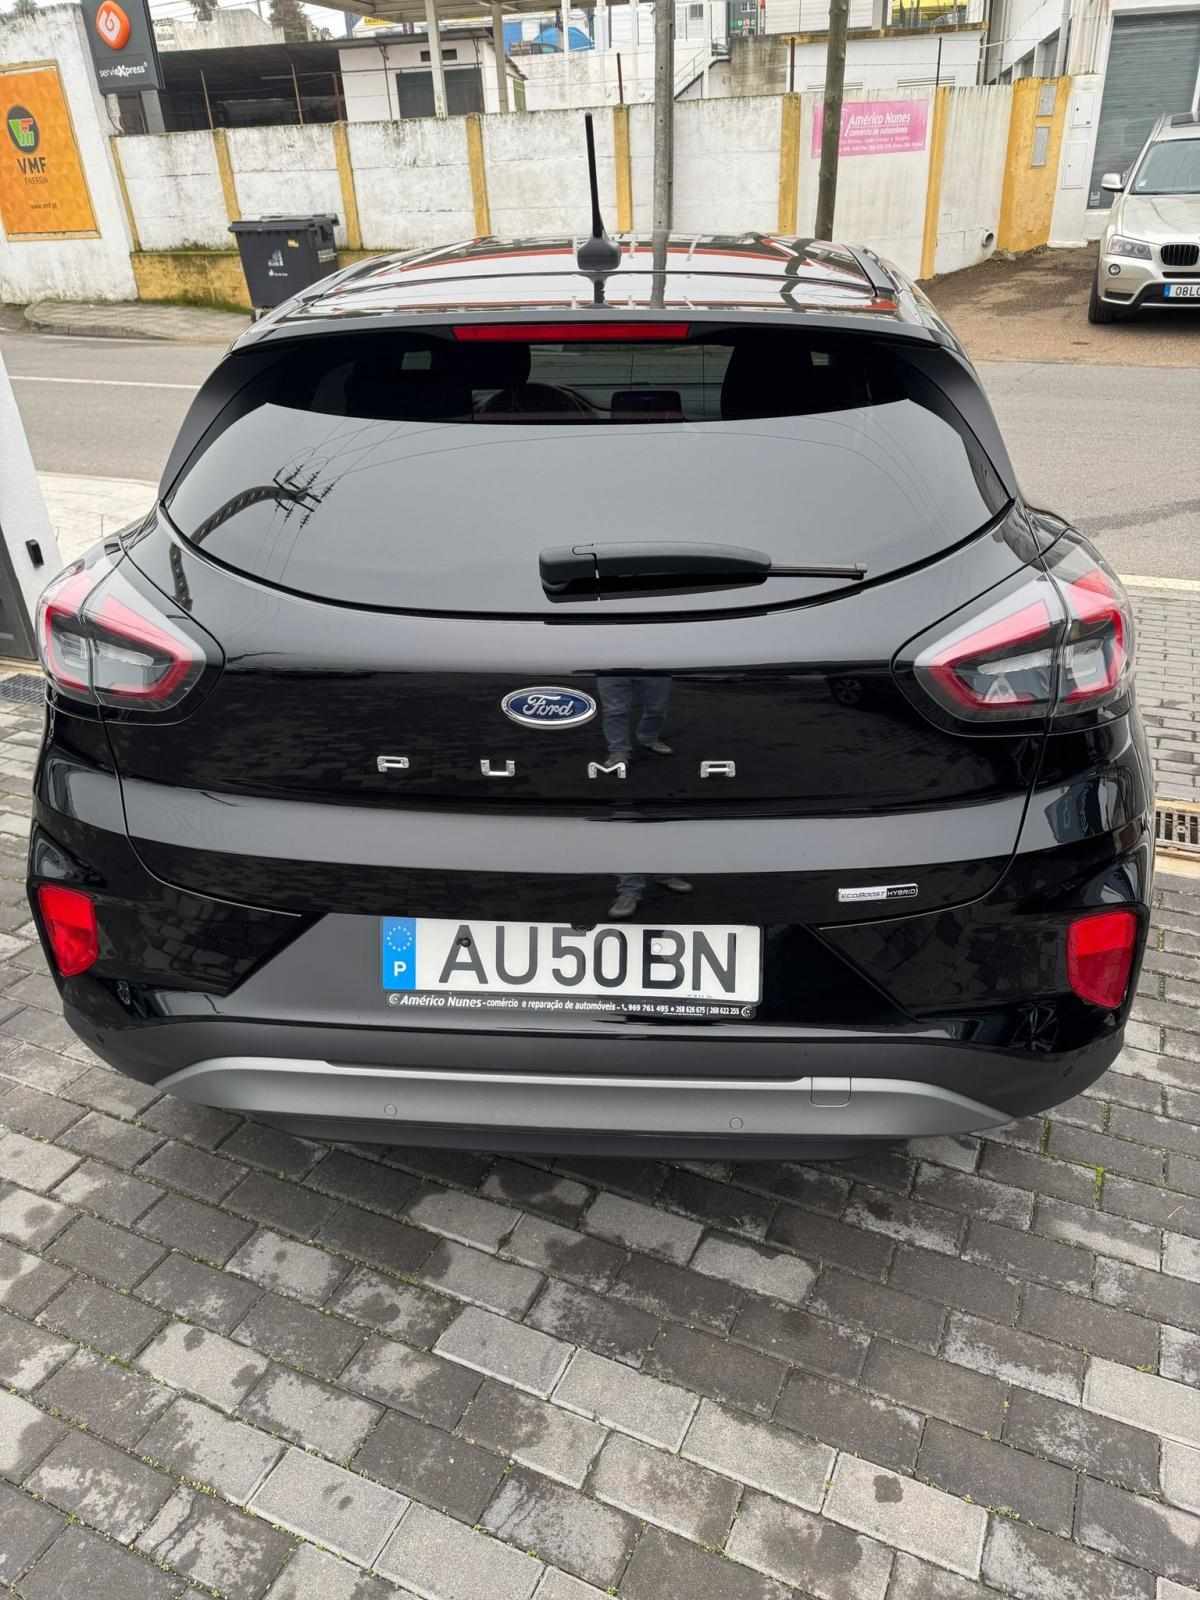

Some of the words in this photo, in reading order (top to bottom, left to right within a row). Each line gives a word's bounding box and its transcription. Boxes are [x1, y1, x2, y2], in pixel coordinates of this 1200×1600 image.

[885, 112, 911, 124] Nunes
[16, 157, 47, 175] VMF
[522, 694, 573, 718] Ford
[377, 755, 736, 779] PUMA
[887, 887, 917, 897] HYBRID
[438, 924, 737, 994] AU50BN
[393, 960, 407, 977] P
[400, 994, 445, 1008] Américo
[564, 1000, 574, 1009] de
